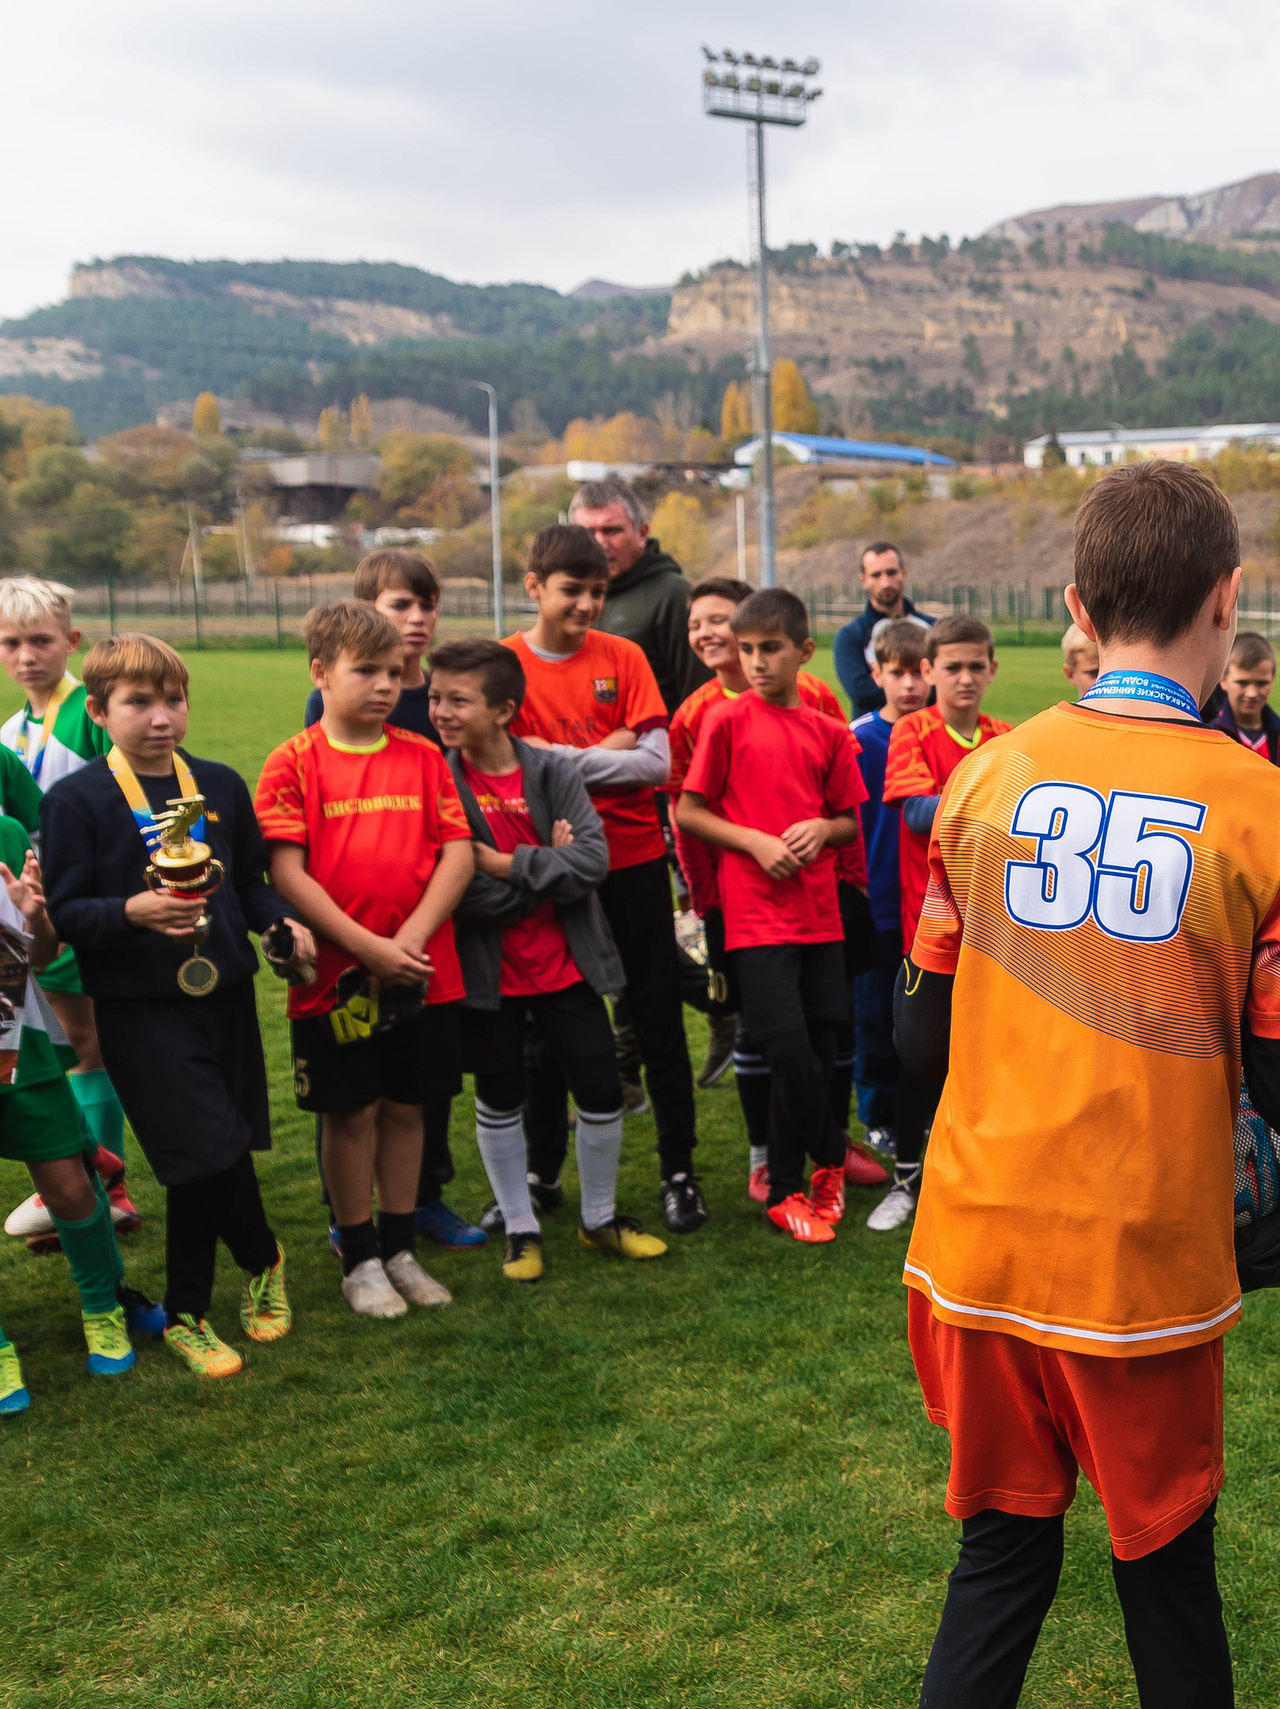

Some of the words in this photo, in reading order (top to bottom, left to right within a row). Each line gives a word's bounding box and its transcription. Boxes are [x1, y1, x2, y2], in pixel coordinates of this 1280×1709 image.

[1121, 675, 1149, 686] ВОДЫ
[1138, 687, 1191, 711] КАВКАЗСКИЕ
[1004, 780, 1209, 943] 35
